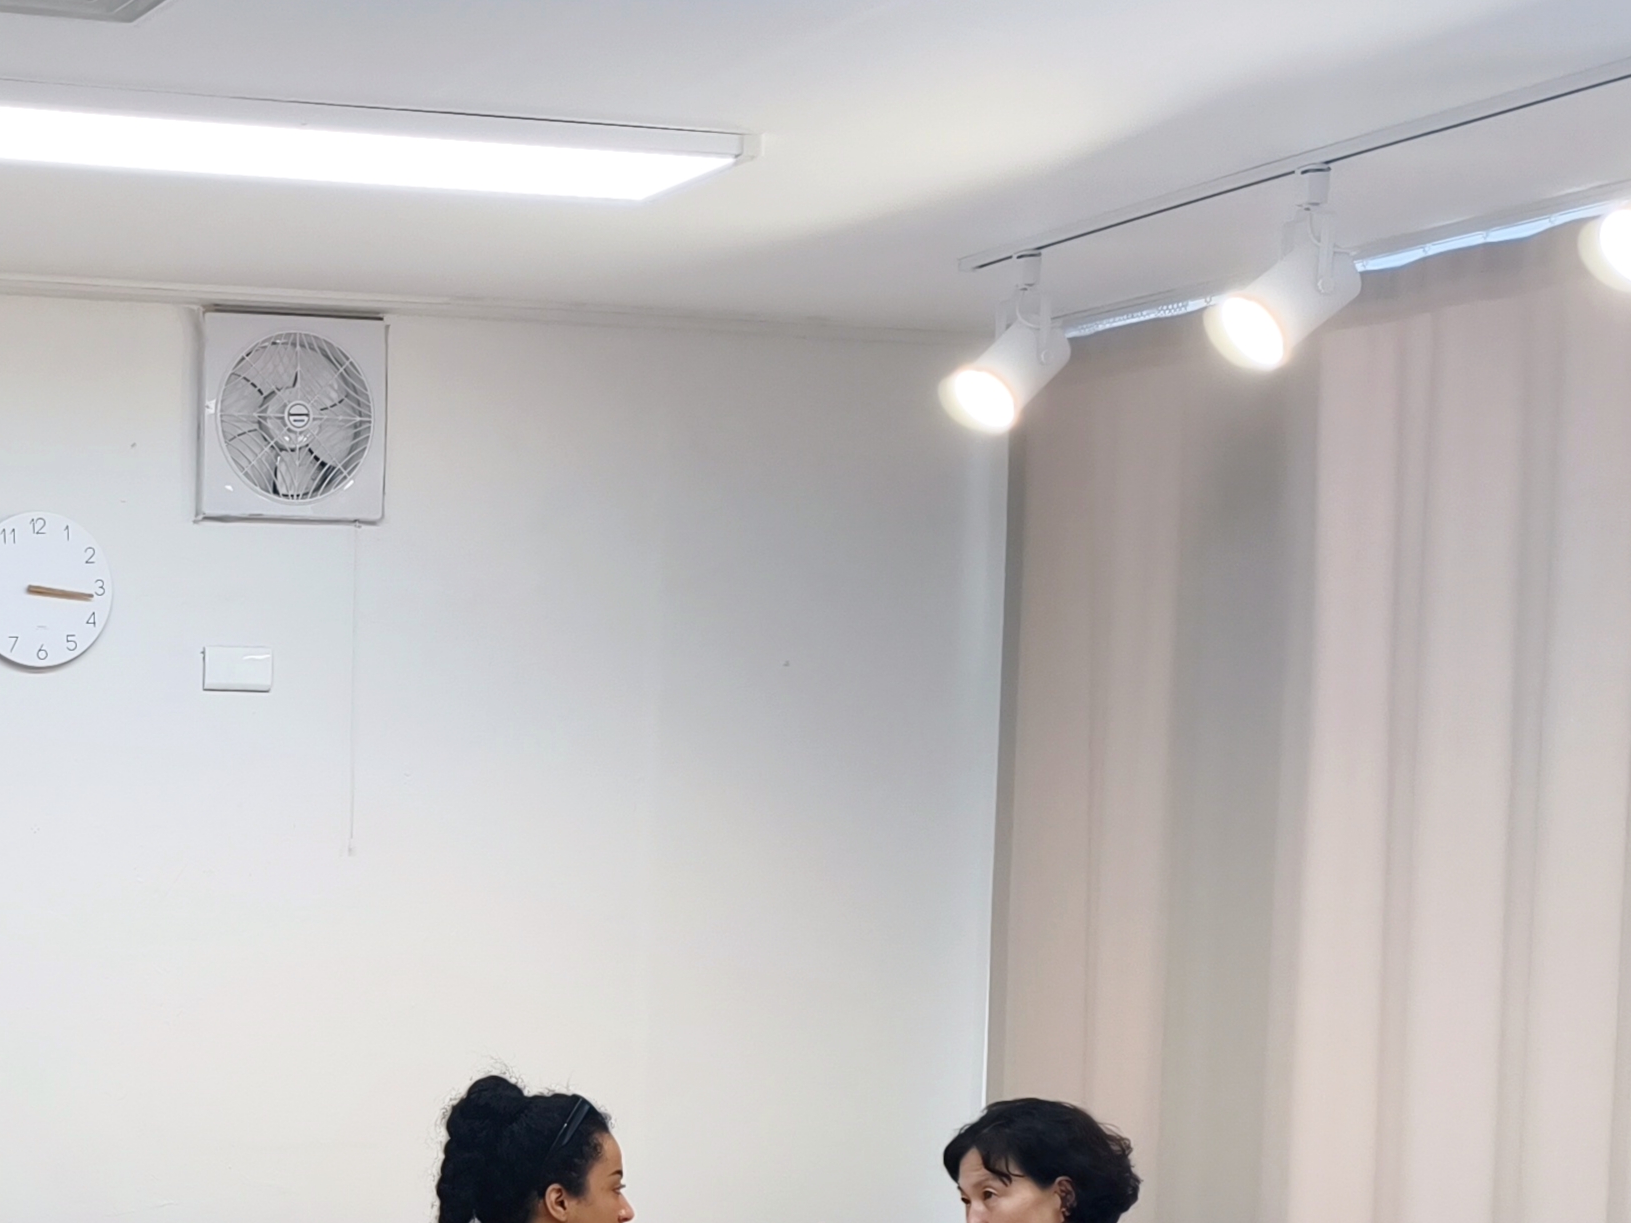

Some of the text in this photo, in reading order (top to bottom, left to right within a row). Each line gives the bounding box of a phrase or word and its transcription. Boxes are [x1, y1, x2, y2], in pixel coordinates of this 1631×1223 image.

[29, 517, 47, 535] 12
[63, 524, 70, 542] 1
[0, 528, 16, 545] 11
[84, 546, 96, 564] 2
[94, 578, 106, 597] 3
[85, 611, 97, 628] 4
[8, 636, 19, 653] 7
[36, 643, 49, 661] 6
[65, 634, 78, 652] 5
